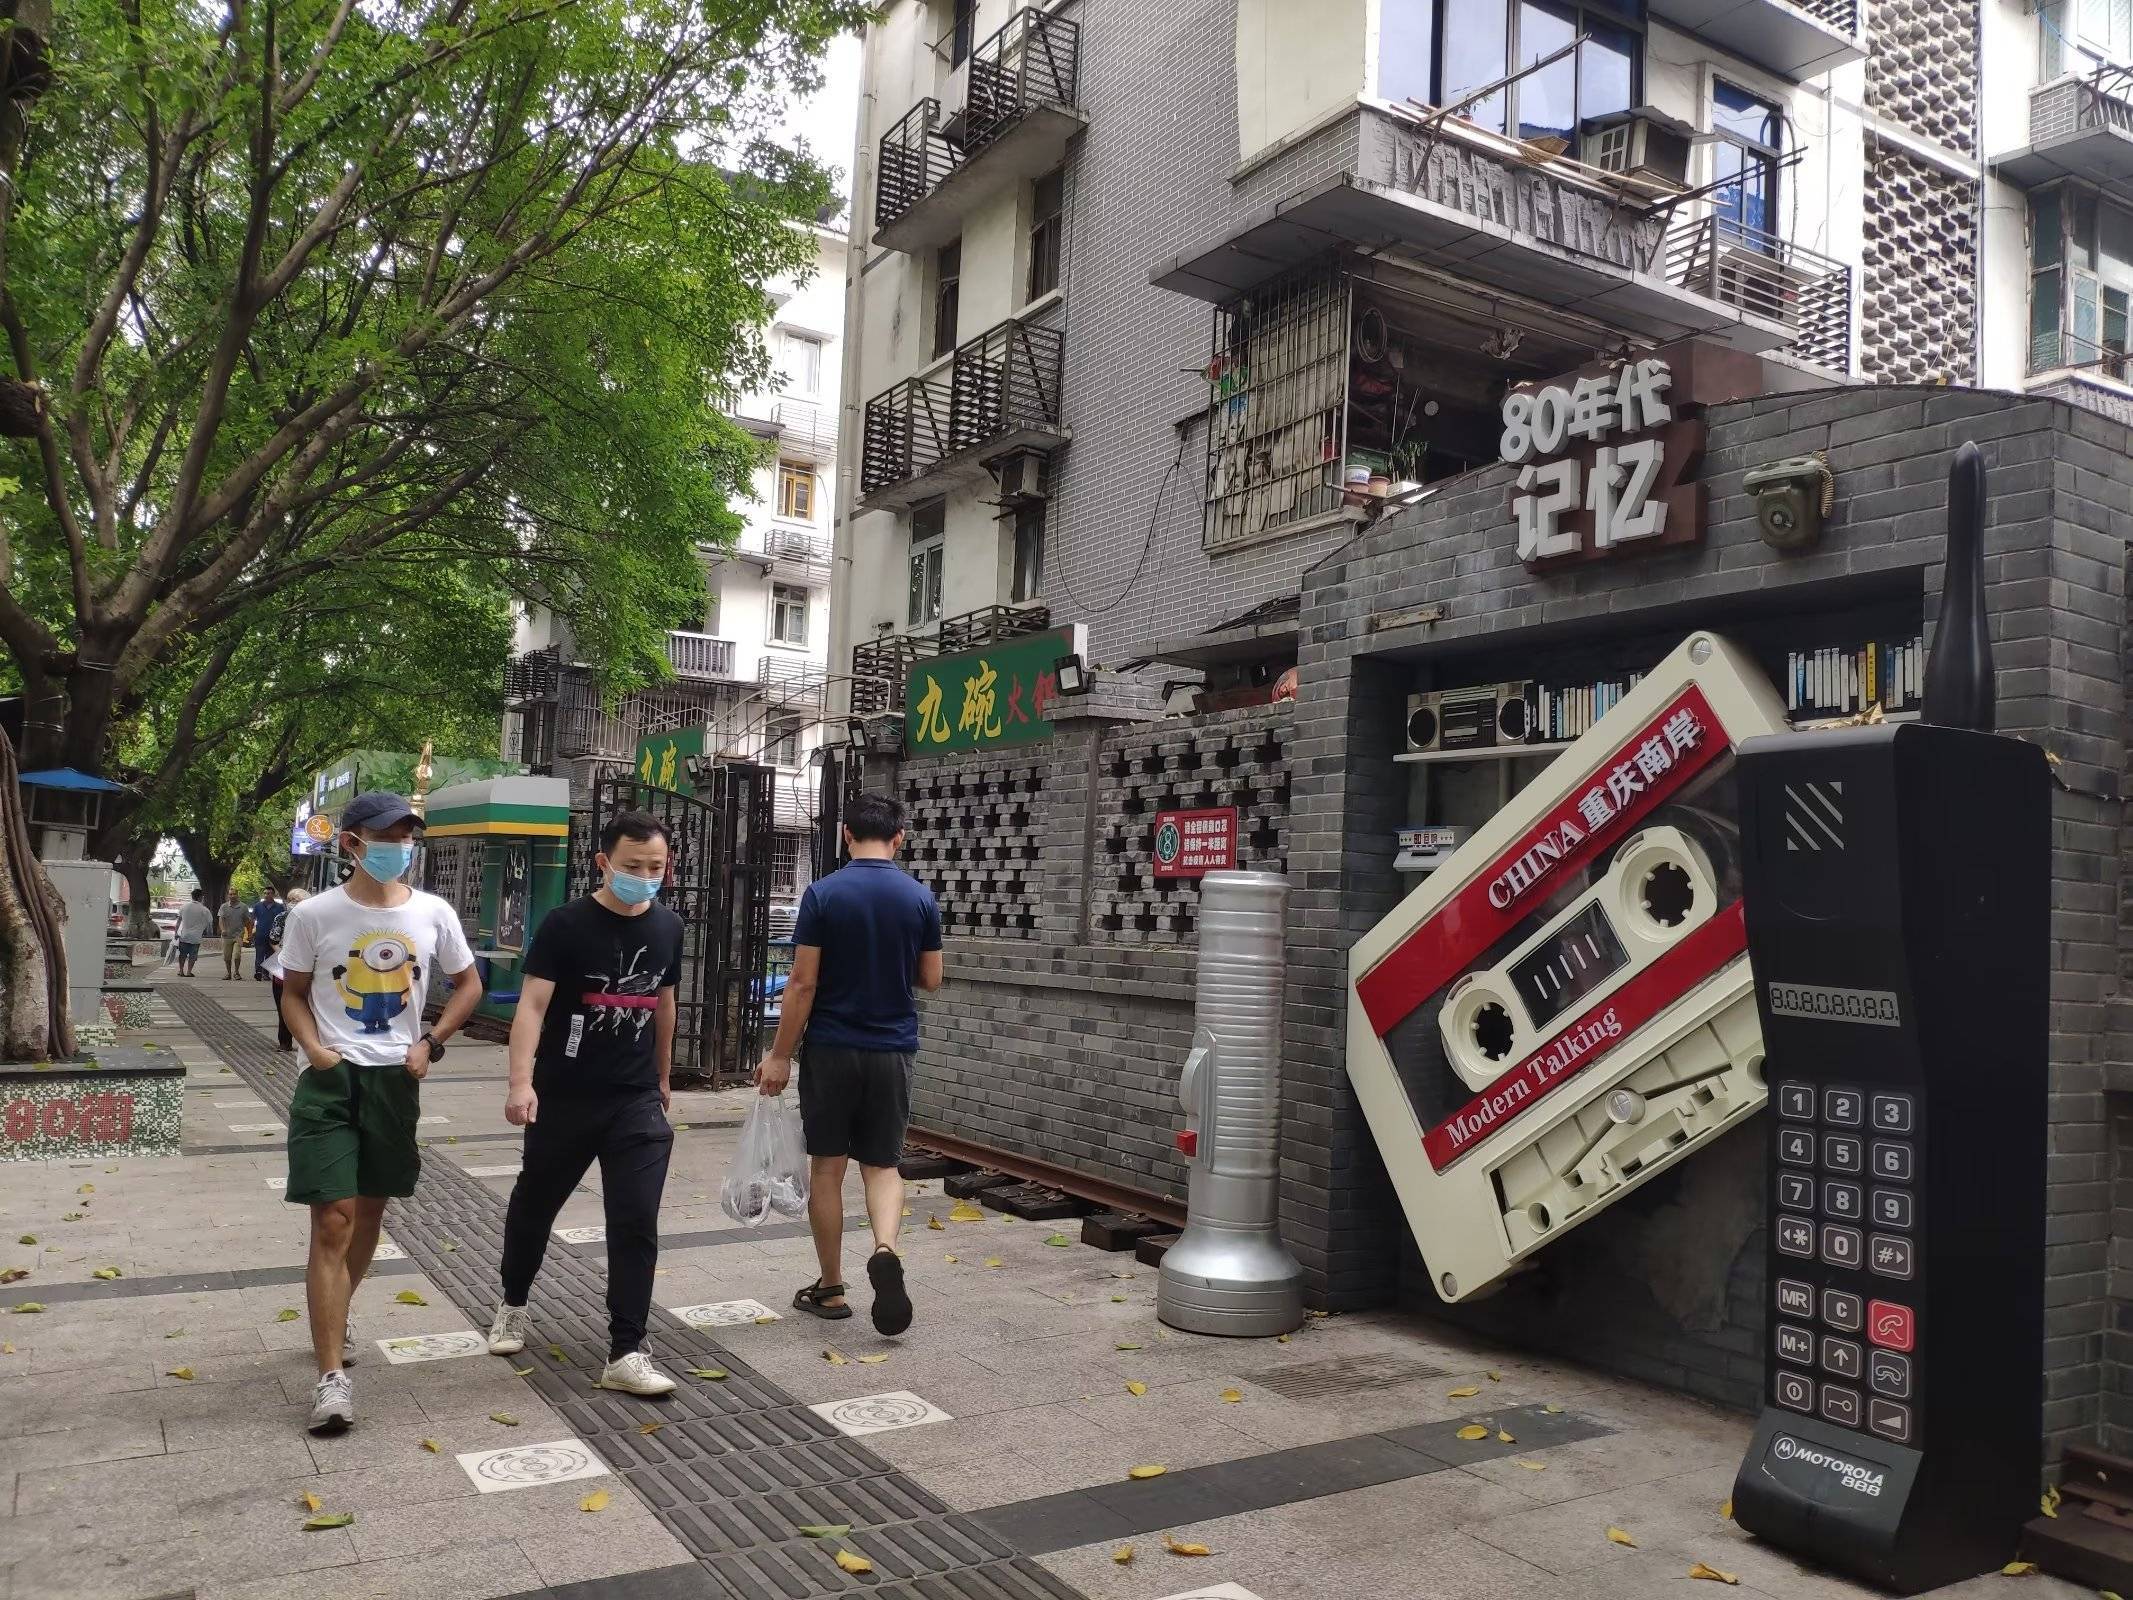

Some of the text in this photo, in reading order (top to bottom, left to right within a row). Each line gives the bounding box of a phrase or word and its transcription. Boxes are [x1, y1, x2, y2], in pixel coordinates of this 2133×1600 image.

[1500, 358, 1673, 463] 80年代
[1512, 440, 1668, 561] 记忆
[641, 740, 690, 792] 九碗
[1488, 708, 1702, 909] CHINA 重庆南岸
[1445, 1008, 1623, 1149] Modern Talking
[1792, 1093, 1900, 1123] 1 2 3
[1790, 1138, 1900, 1171] 4 5 6
[1790, 1182, 1900, 1218] 7 8 9
[1834, 1236, 1849, 1256] 0
[1782, 1288, 1848, 1318] MR C
[1782, 1334, 1808, 1352] M+
[1795, 1448, 1884, 1486] MOTOROLA
[1841, 1475, 1881, 1497] 888
